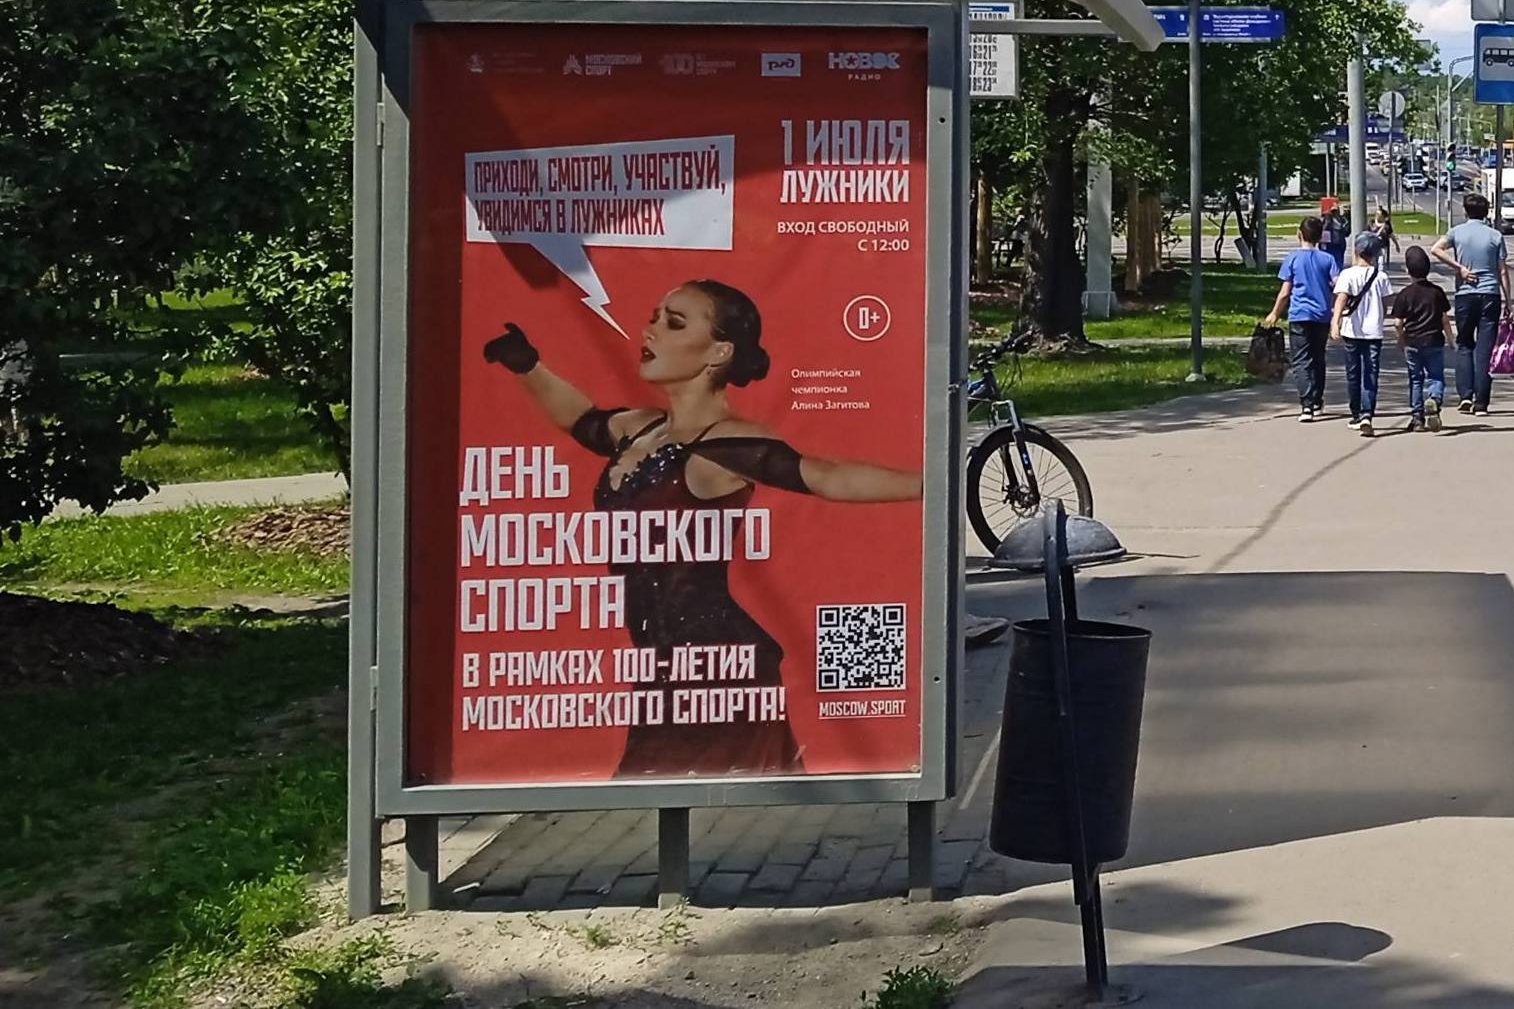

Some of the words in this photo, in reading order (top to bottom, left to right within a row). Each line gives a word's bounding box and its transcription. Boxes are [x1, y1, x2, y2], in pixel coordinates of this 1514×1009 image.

[781, 120, 793, 165] 1
[806, 119, 910, 165] ИЮЛЯ
[474, 158, 544, 196] ПРИХОДИ,
[548, 152, 618, 195] СМОТРИ,
[623, 144, 727, 195] УЧАСТВУЙ,
[779, 170, 909, 204] ЛУЖНИКИ
[476, 198, 552, 235] УВИДИМСЯ
[556, 200, 567, 233] В
[569, 197, 665, 236] ЛУЖНИКАХ
[777, 221, 816, 237] ВХОД
[818, 218, 910, 235] СВОБОДНЫЙ
[857, 239, 868, 252] С
[871, 238, 910, 252] 12:00
[858, 307, 881, 330] 0+
[791, 368, 861, 381] Олимпийская
[791, 385, 848, 395] чемпионка
[791, 399, 822, 411] Алина
[825, 399, 870, 410] Загитова
[460, 446, 570, 506] ДЕНЬ
[460, 507, 771, 567] МОСКОВСКОГО
[460, 575, 626, 632] СПОРТА
[462, 652, 480, 688] В
[489, 649, 604, 687] РАМКАХ
[612, 644, 756, 684] 100-ЛЕТИЯ
[462, 693, 664, 731] МОСКОВСКОГО
[672, 687, 786, 725] СПОРТА!
[818, 699, 906, 717] MOSCOW.SPORT
